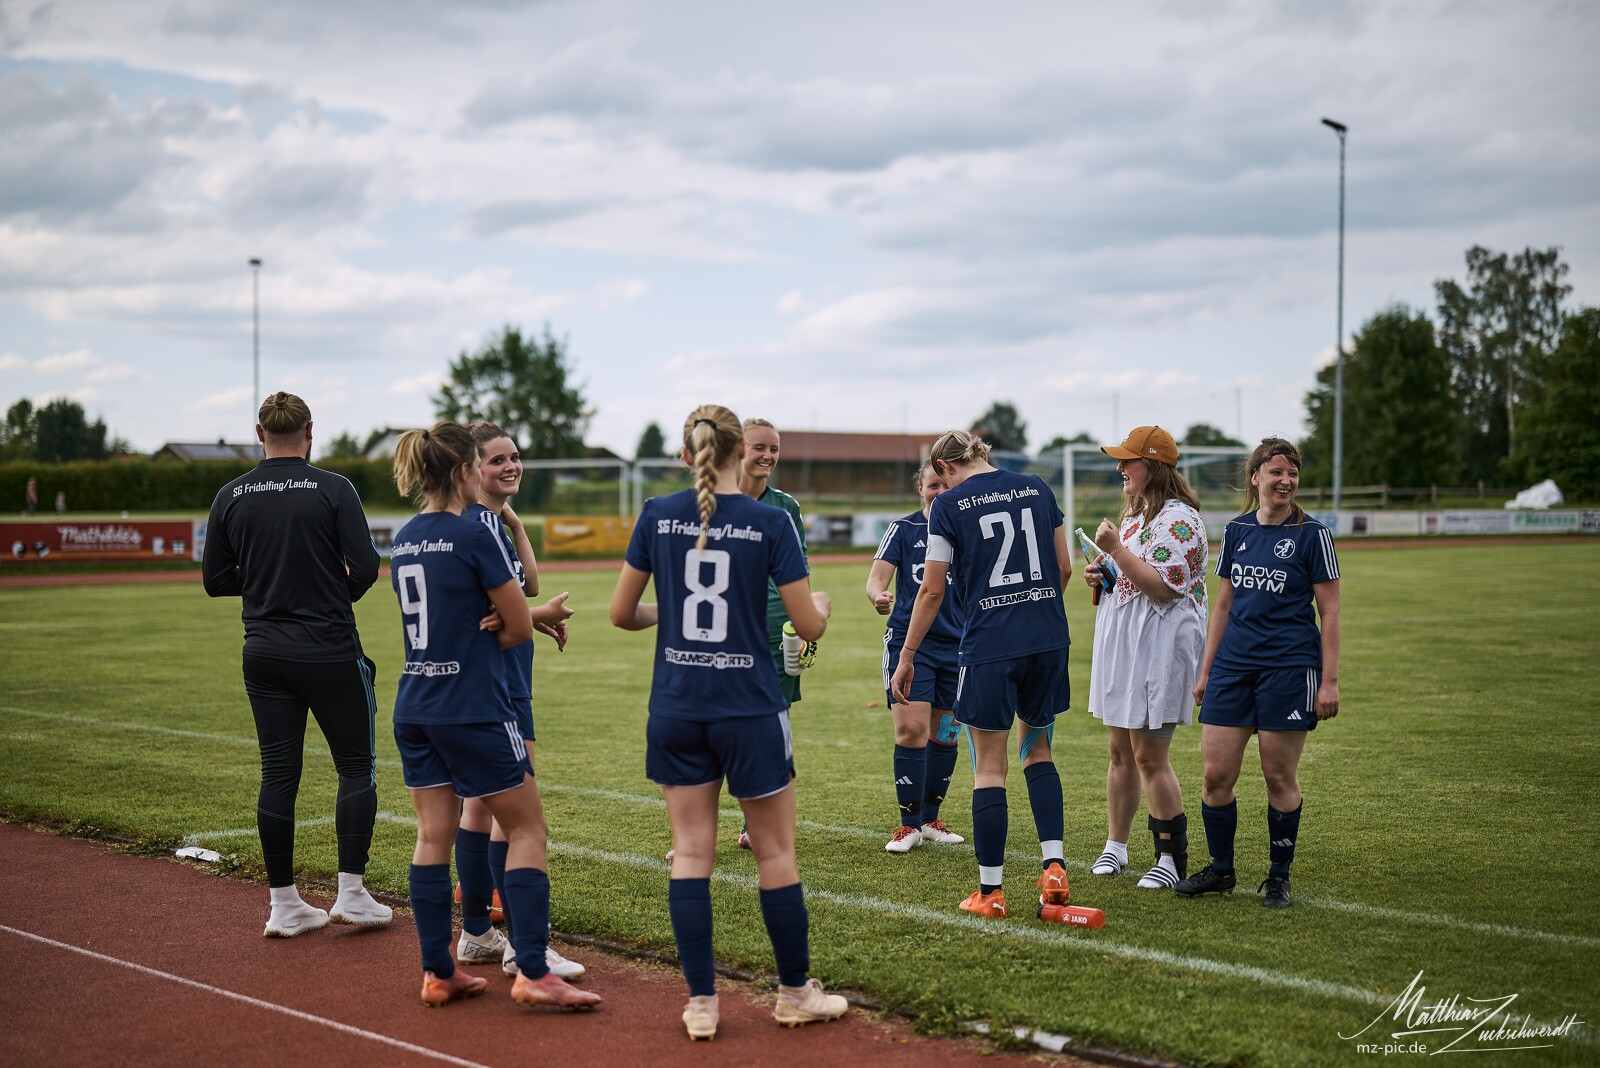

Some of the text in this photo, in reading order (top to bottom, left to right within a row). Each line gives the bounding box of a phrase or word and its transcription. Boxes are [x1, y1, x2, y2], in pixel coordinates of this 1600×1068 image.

[233, 478, 318, 497] SG Fridolfing/Laufen
[958, 487, 1040, 511] SG Fridolfing/Laufen
[657, 520, 762, 542] SG Fridoling/Laufen
[979, 507, 1043, 588] 21
[1243, 565, 1287, 582] nova
[682, 548, 731, 643] 8
[1243, 577, 1285, 594] GYM
[398, 563, 428, 650] 9
[1071, 915, 1088, 924] JAKO
